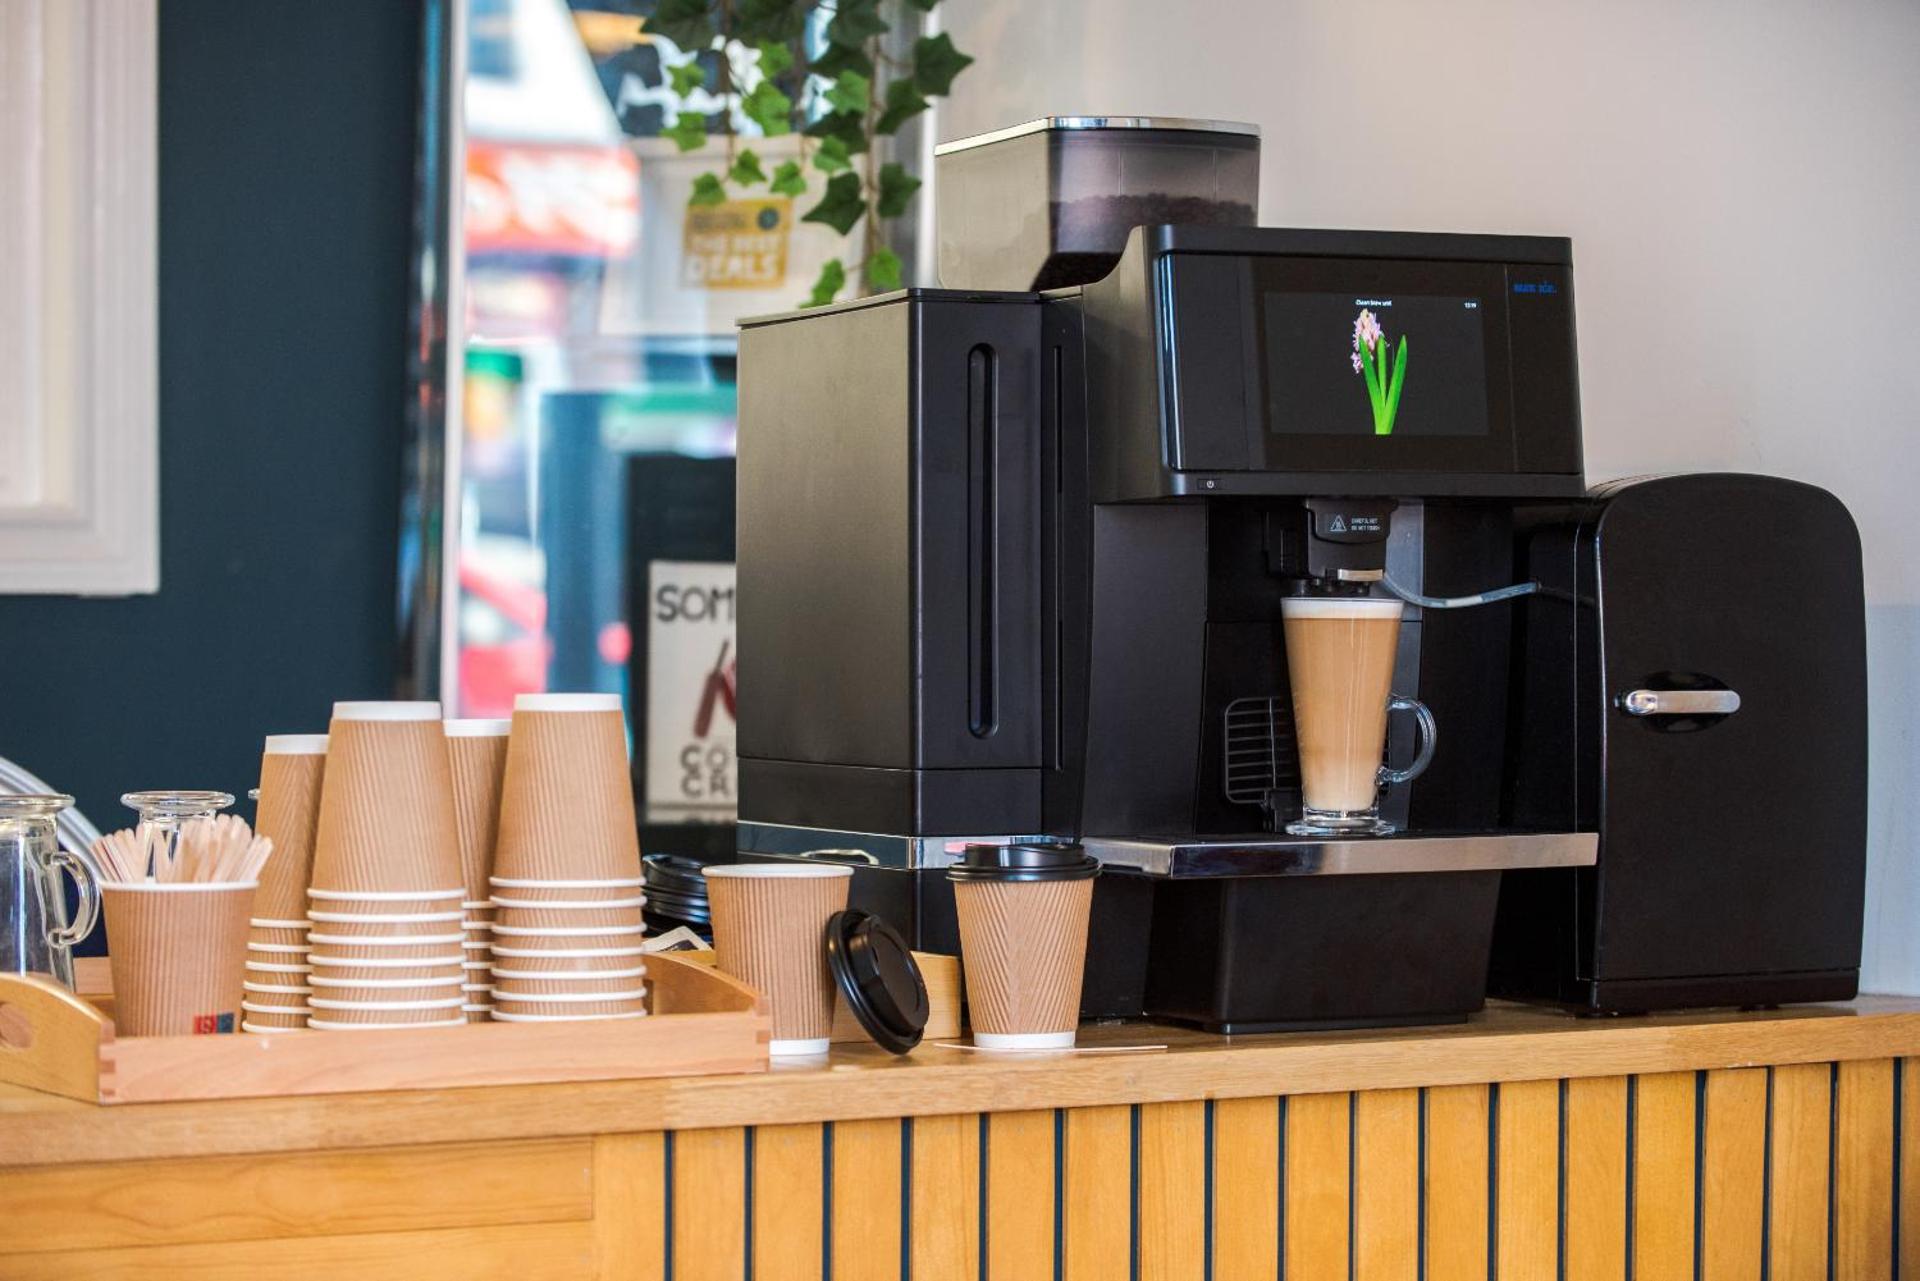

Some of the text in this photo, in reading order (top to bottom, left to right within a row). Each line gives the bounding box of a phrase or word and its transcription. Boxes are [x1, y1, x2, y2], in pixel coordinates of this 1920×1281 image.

[685, 255, 778, 280] DEALS
[656, 584, 736, 622] SOM
[680, 745, 729, 770] CO
